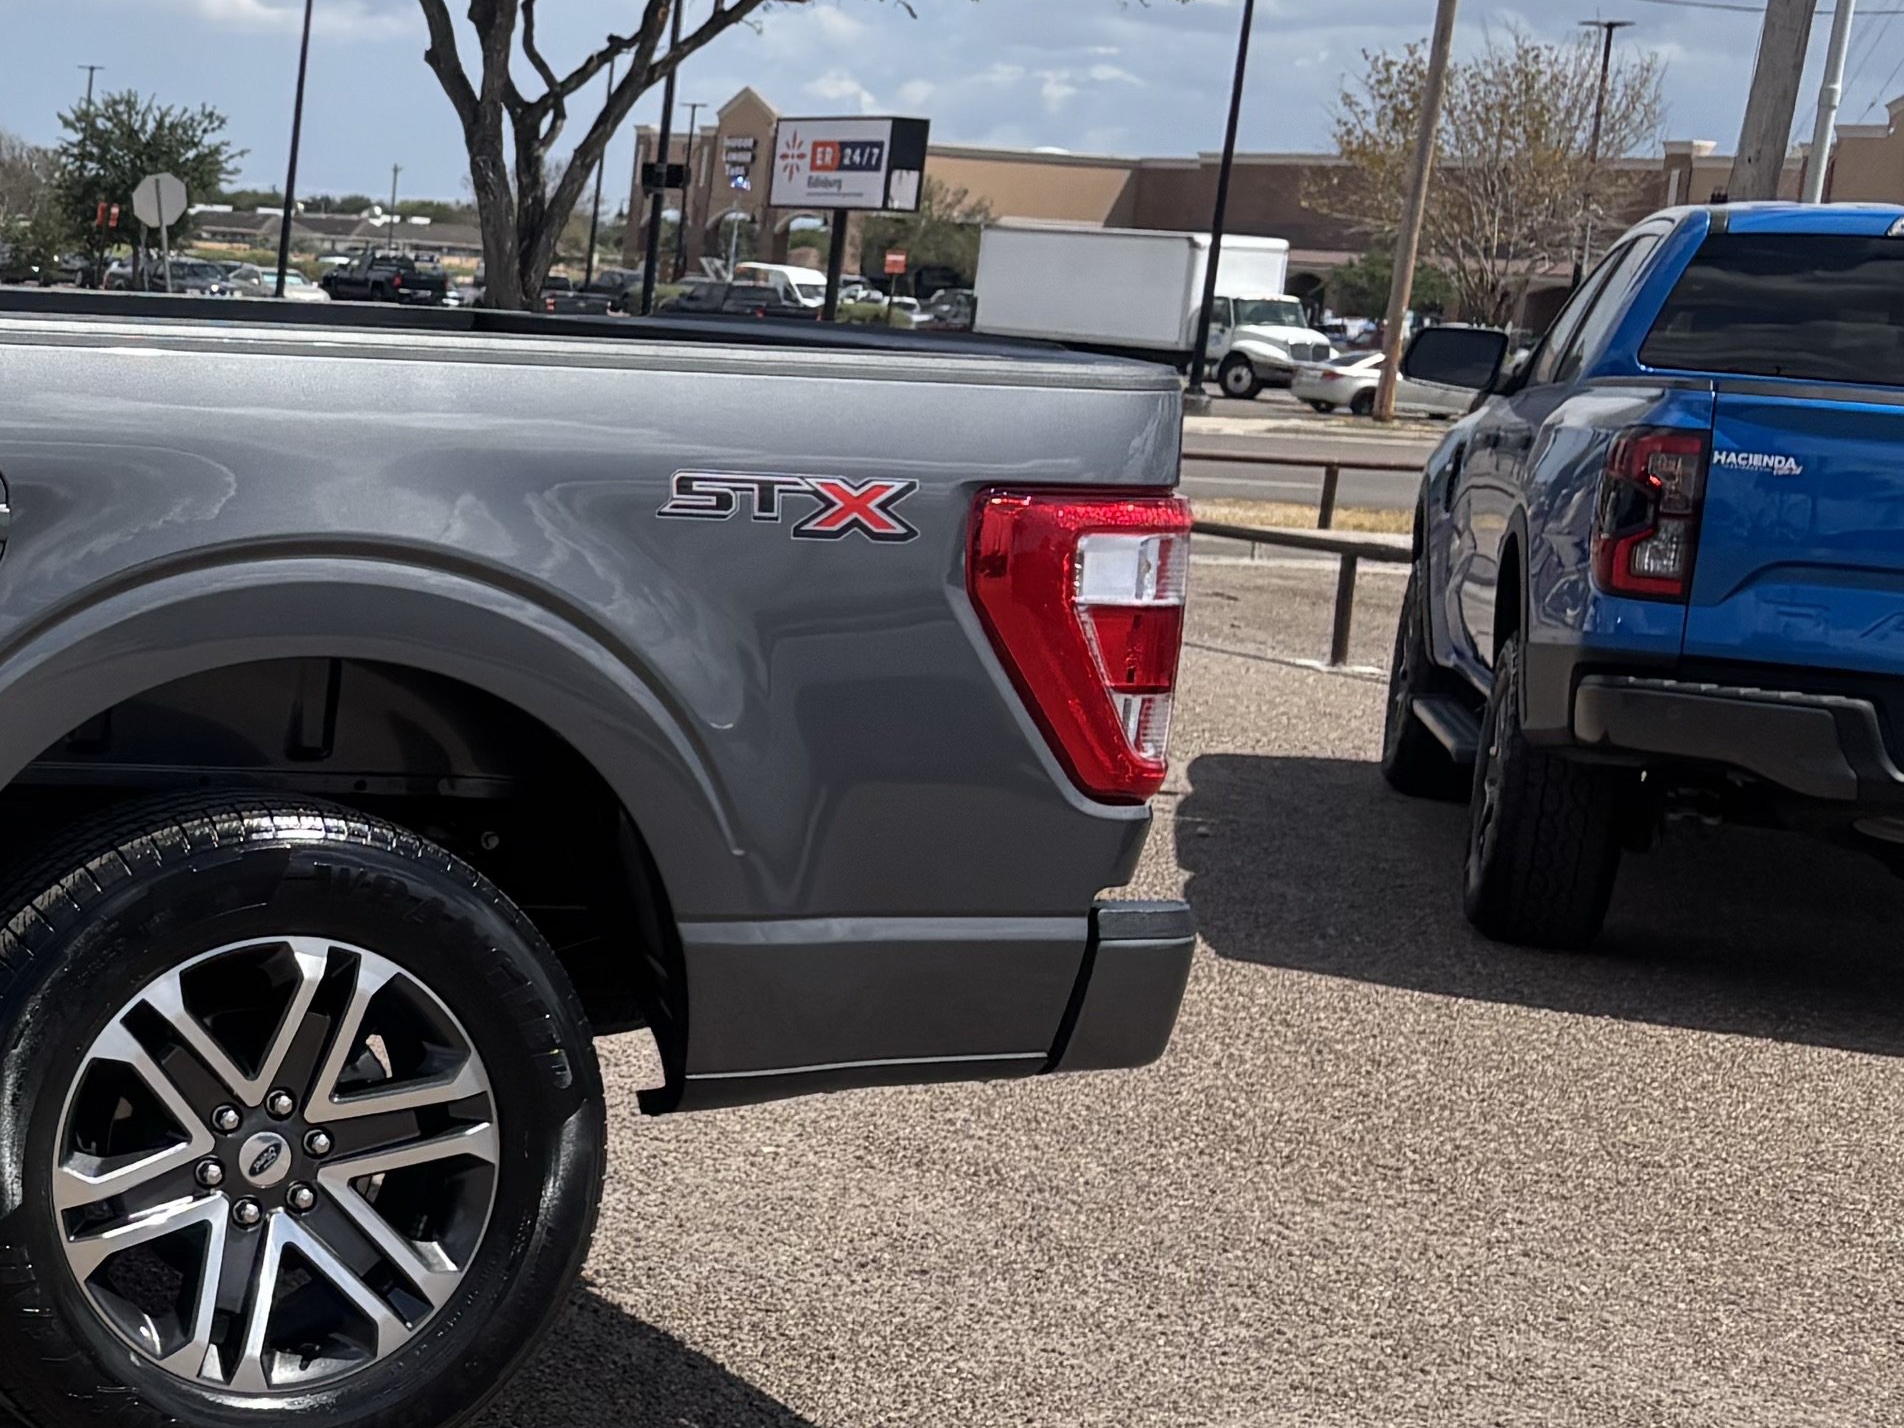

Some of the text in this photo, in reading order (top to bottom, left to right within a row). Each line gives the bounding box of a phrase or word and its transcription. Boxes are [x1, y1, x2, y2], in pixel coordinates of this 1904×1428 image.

[816, 146, 880, 166] ER 24/7
[1713, 451, 1797, 469] HACIENDA
[656, 469, 920, 544] STX
